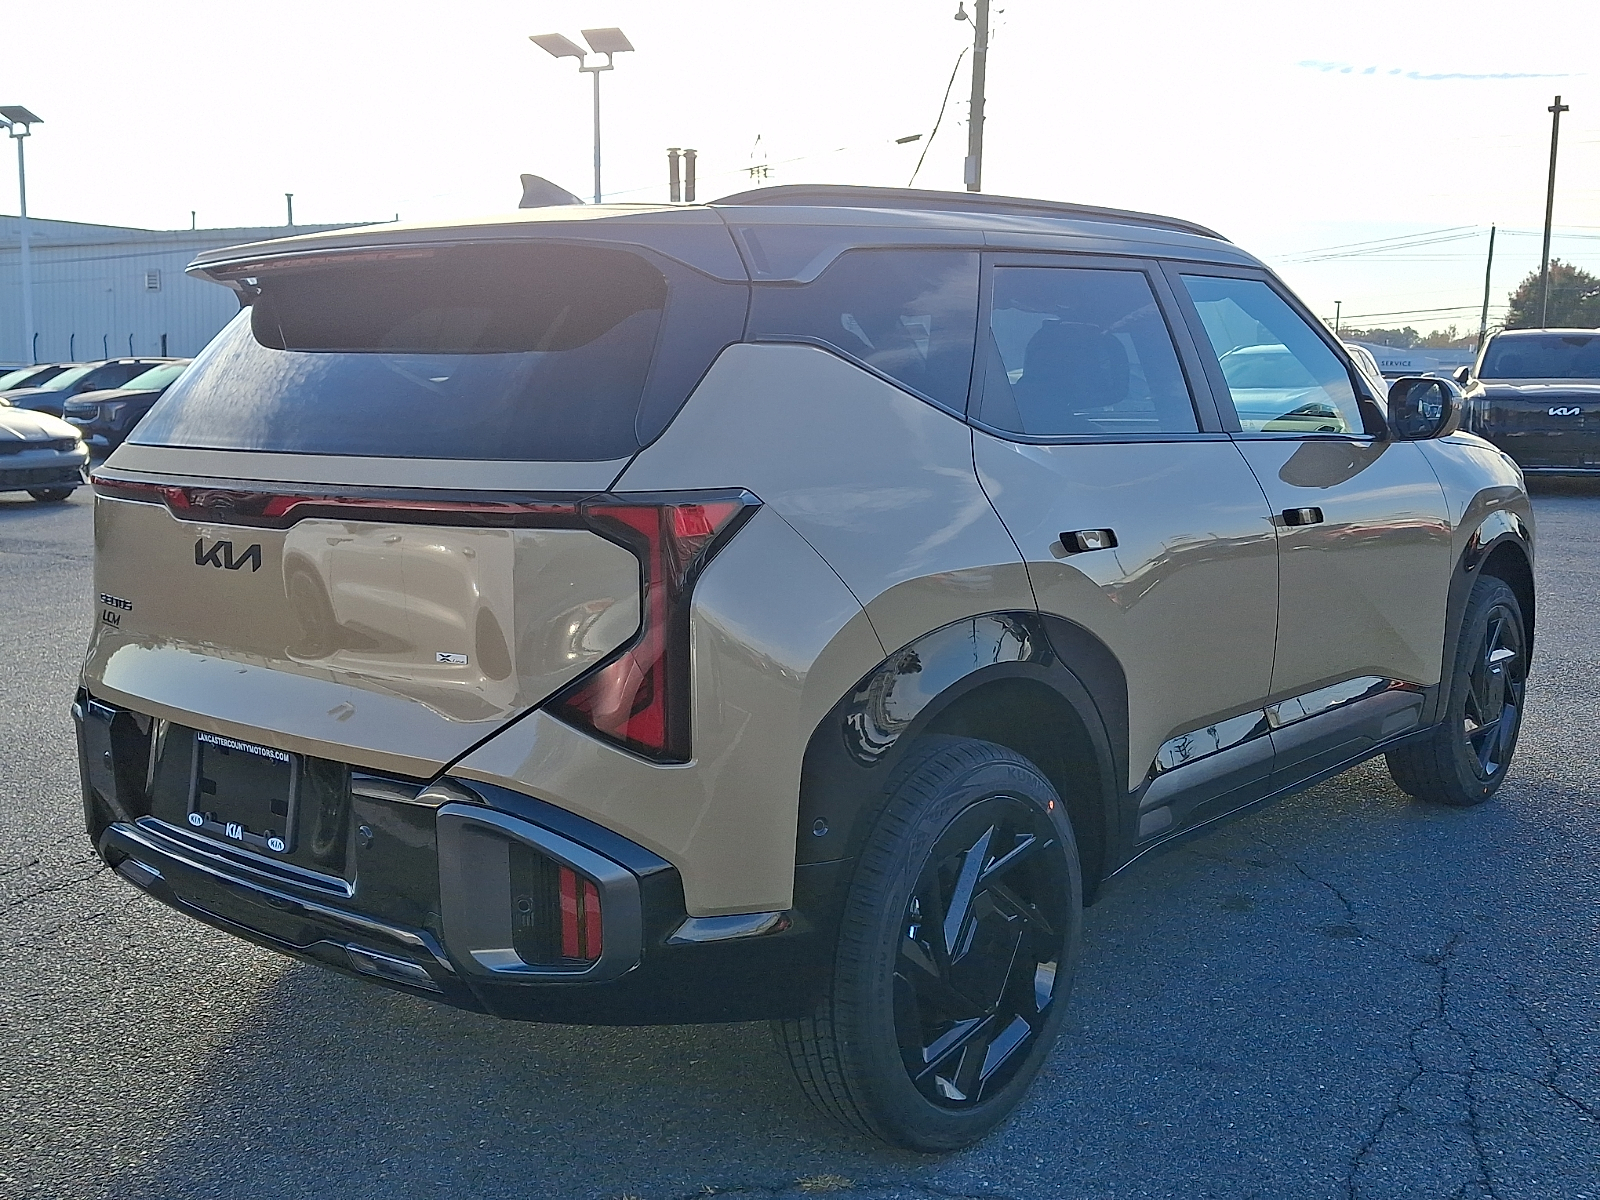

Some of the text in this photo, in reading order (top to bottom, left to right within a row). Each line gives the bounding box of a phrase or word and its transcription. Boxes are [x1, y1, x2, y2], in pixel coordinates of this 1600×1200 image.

[1548, 407, 1580, 416] KIA
[195, 538, 262, 573] KIA
[197, 732, 290, 762] LANCASTERCOUNTYMOTORS.COM
[225, 822, 242, 840] KIA
